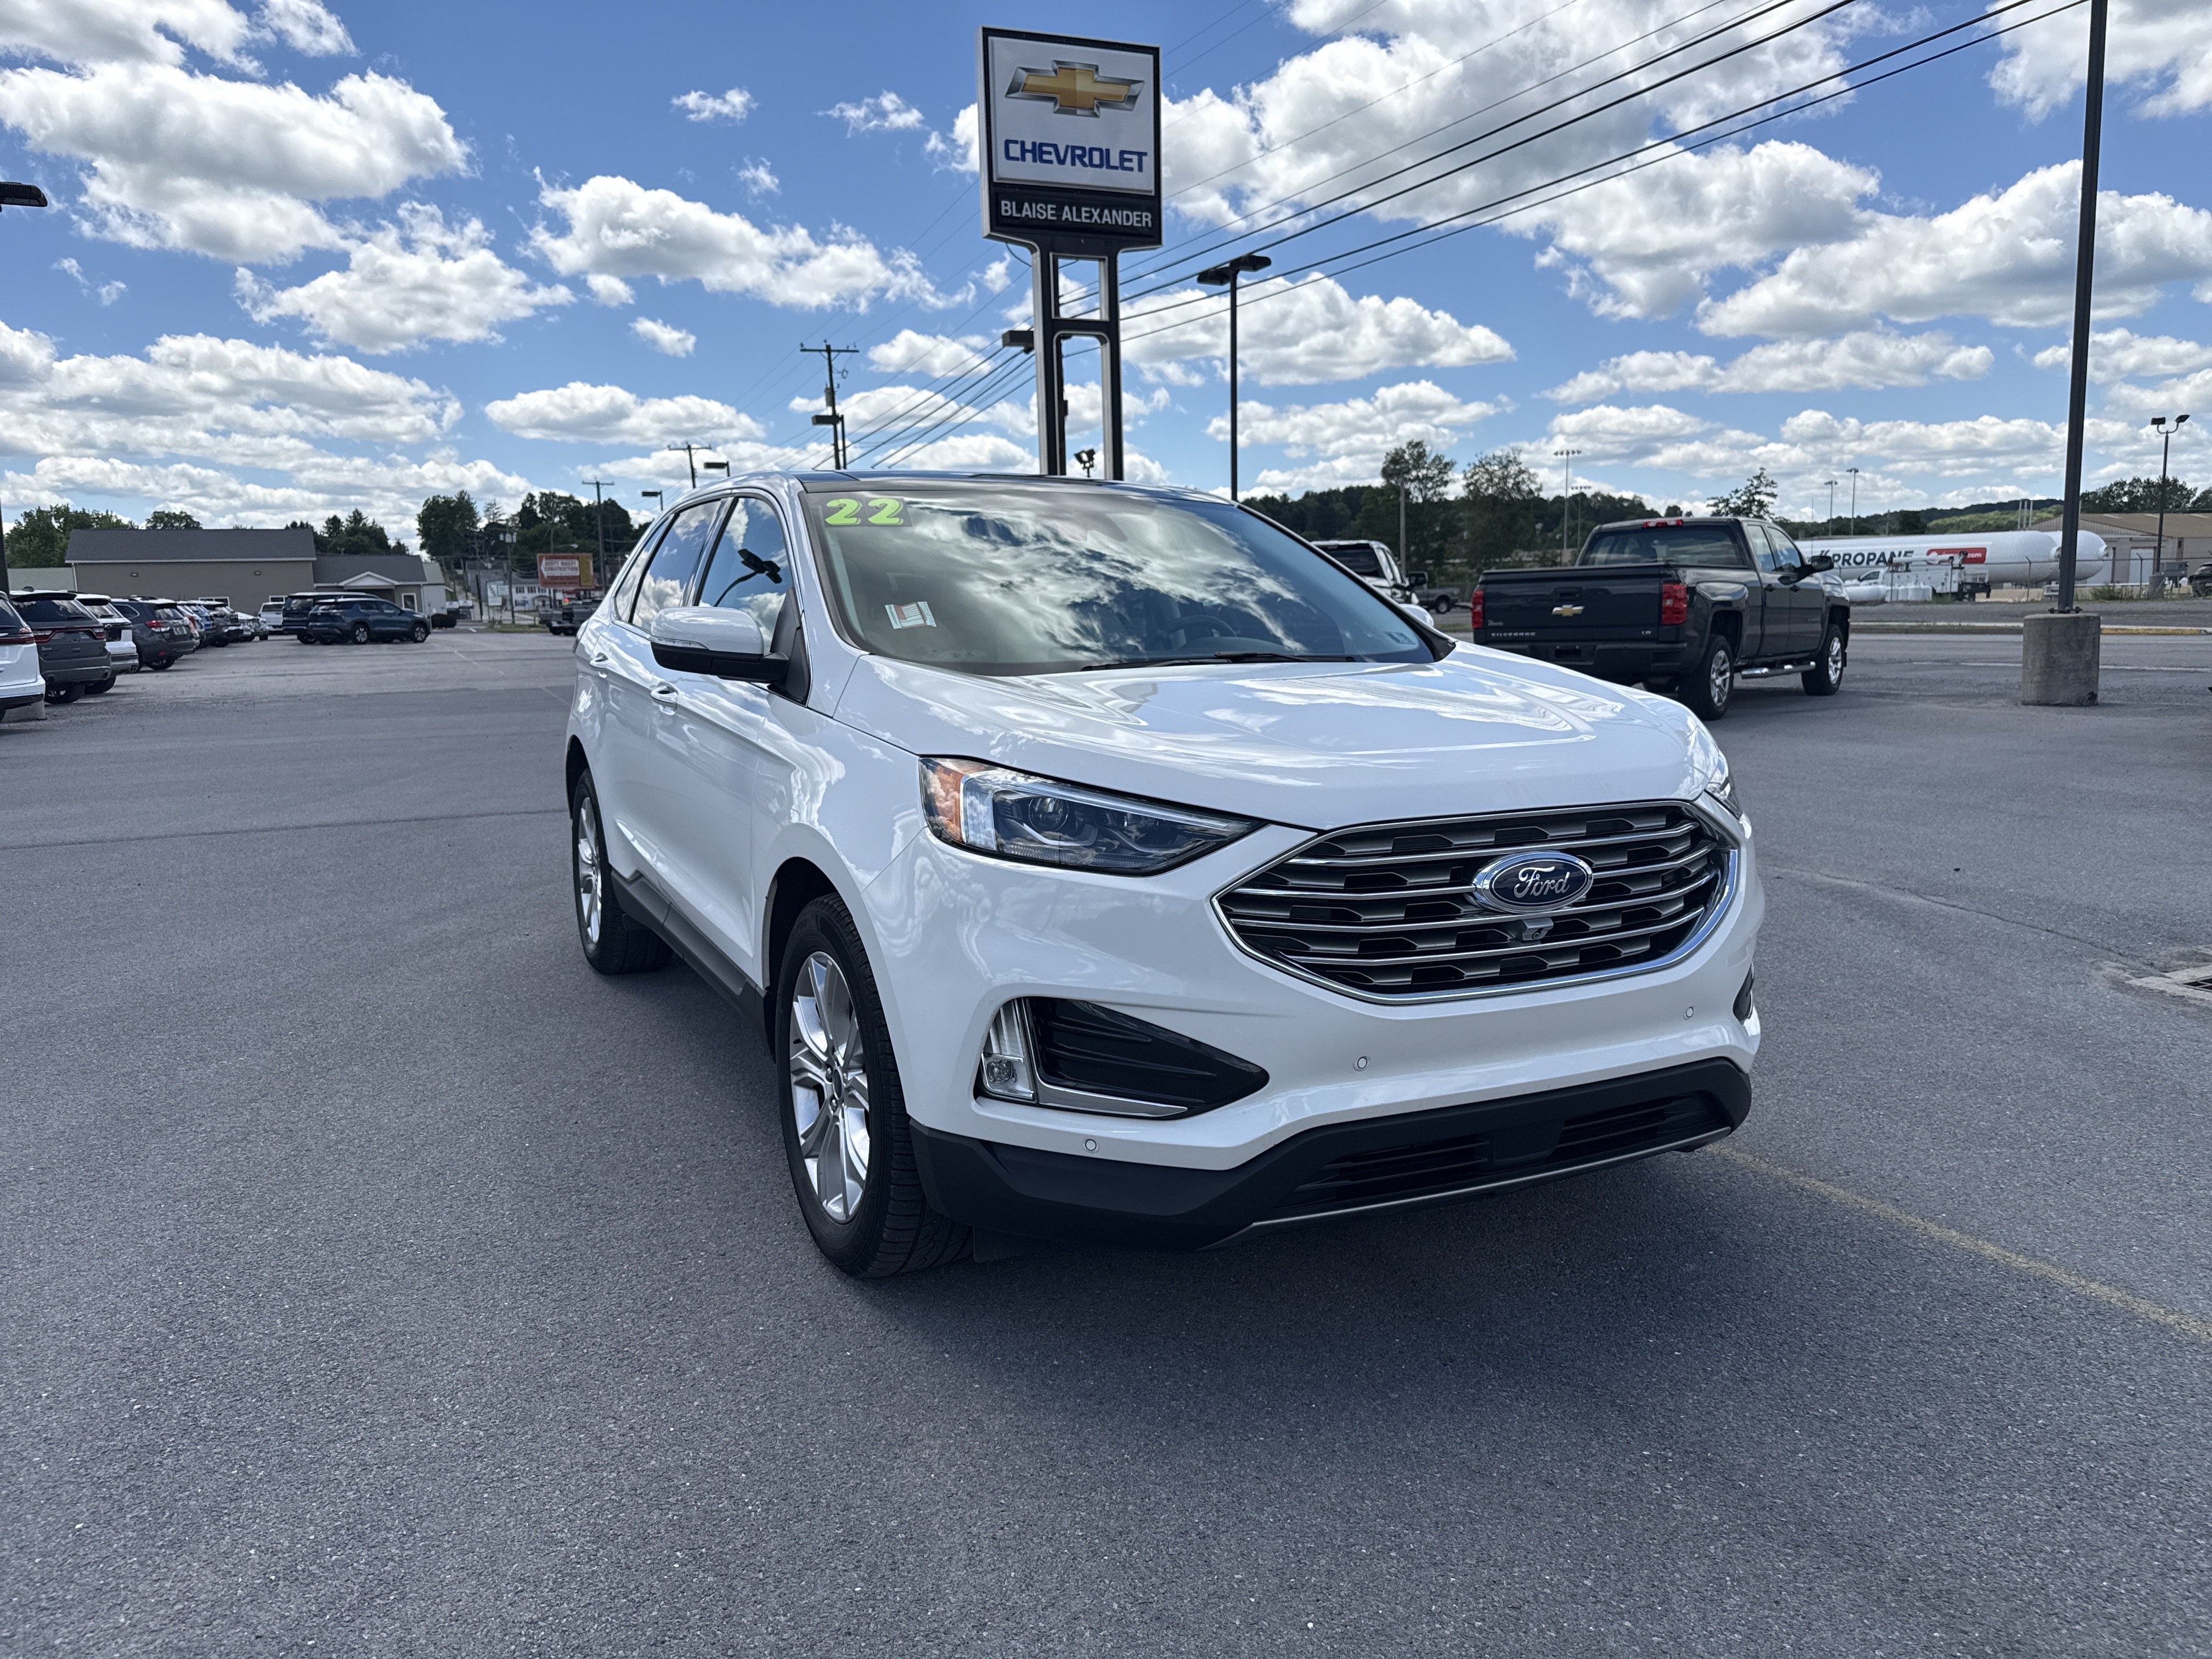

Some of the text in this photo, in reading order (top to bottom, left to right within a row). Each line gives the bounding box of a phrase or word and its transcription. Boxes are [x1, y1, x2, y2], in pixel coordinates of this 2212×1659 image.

[1004, 138, 1148, 173] CHEVROLET
[1000, 200, 1152, 228] BLAISE ALEXANDER
[825, 498, 904, 526] 22
[1514, 866, 1570, 899] Ford
